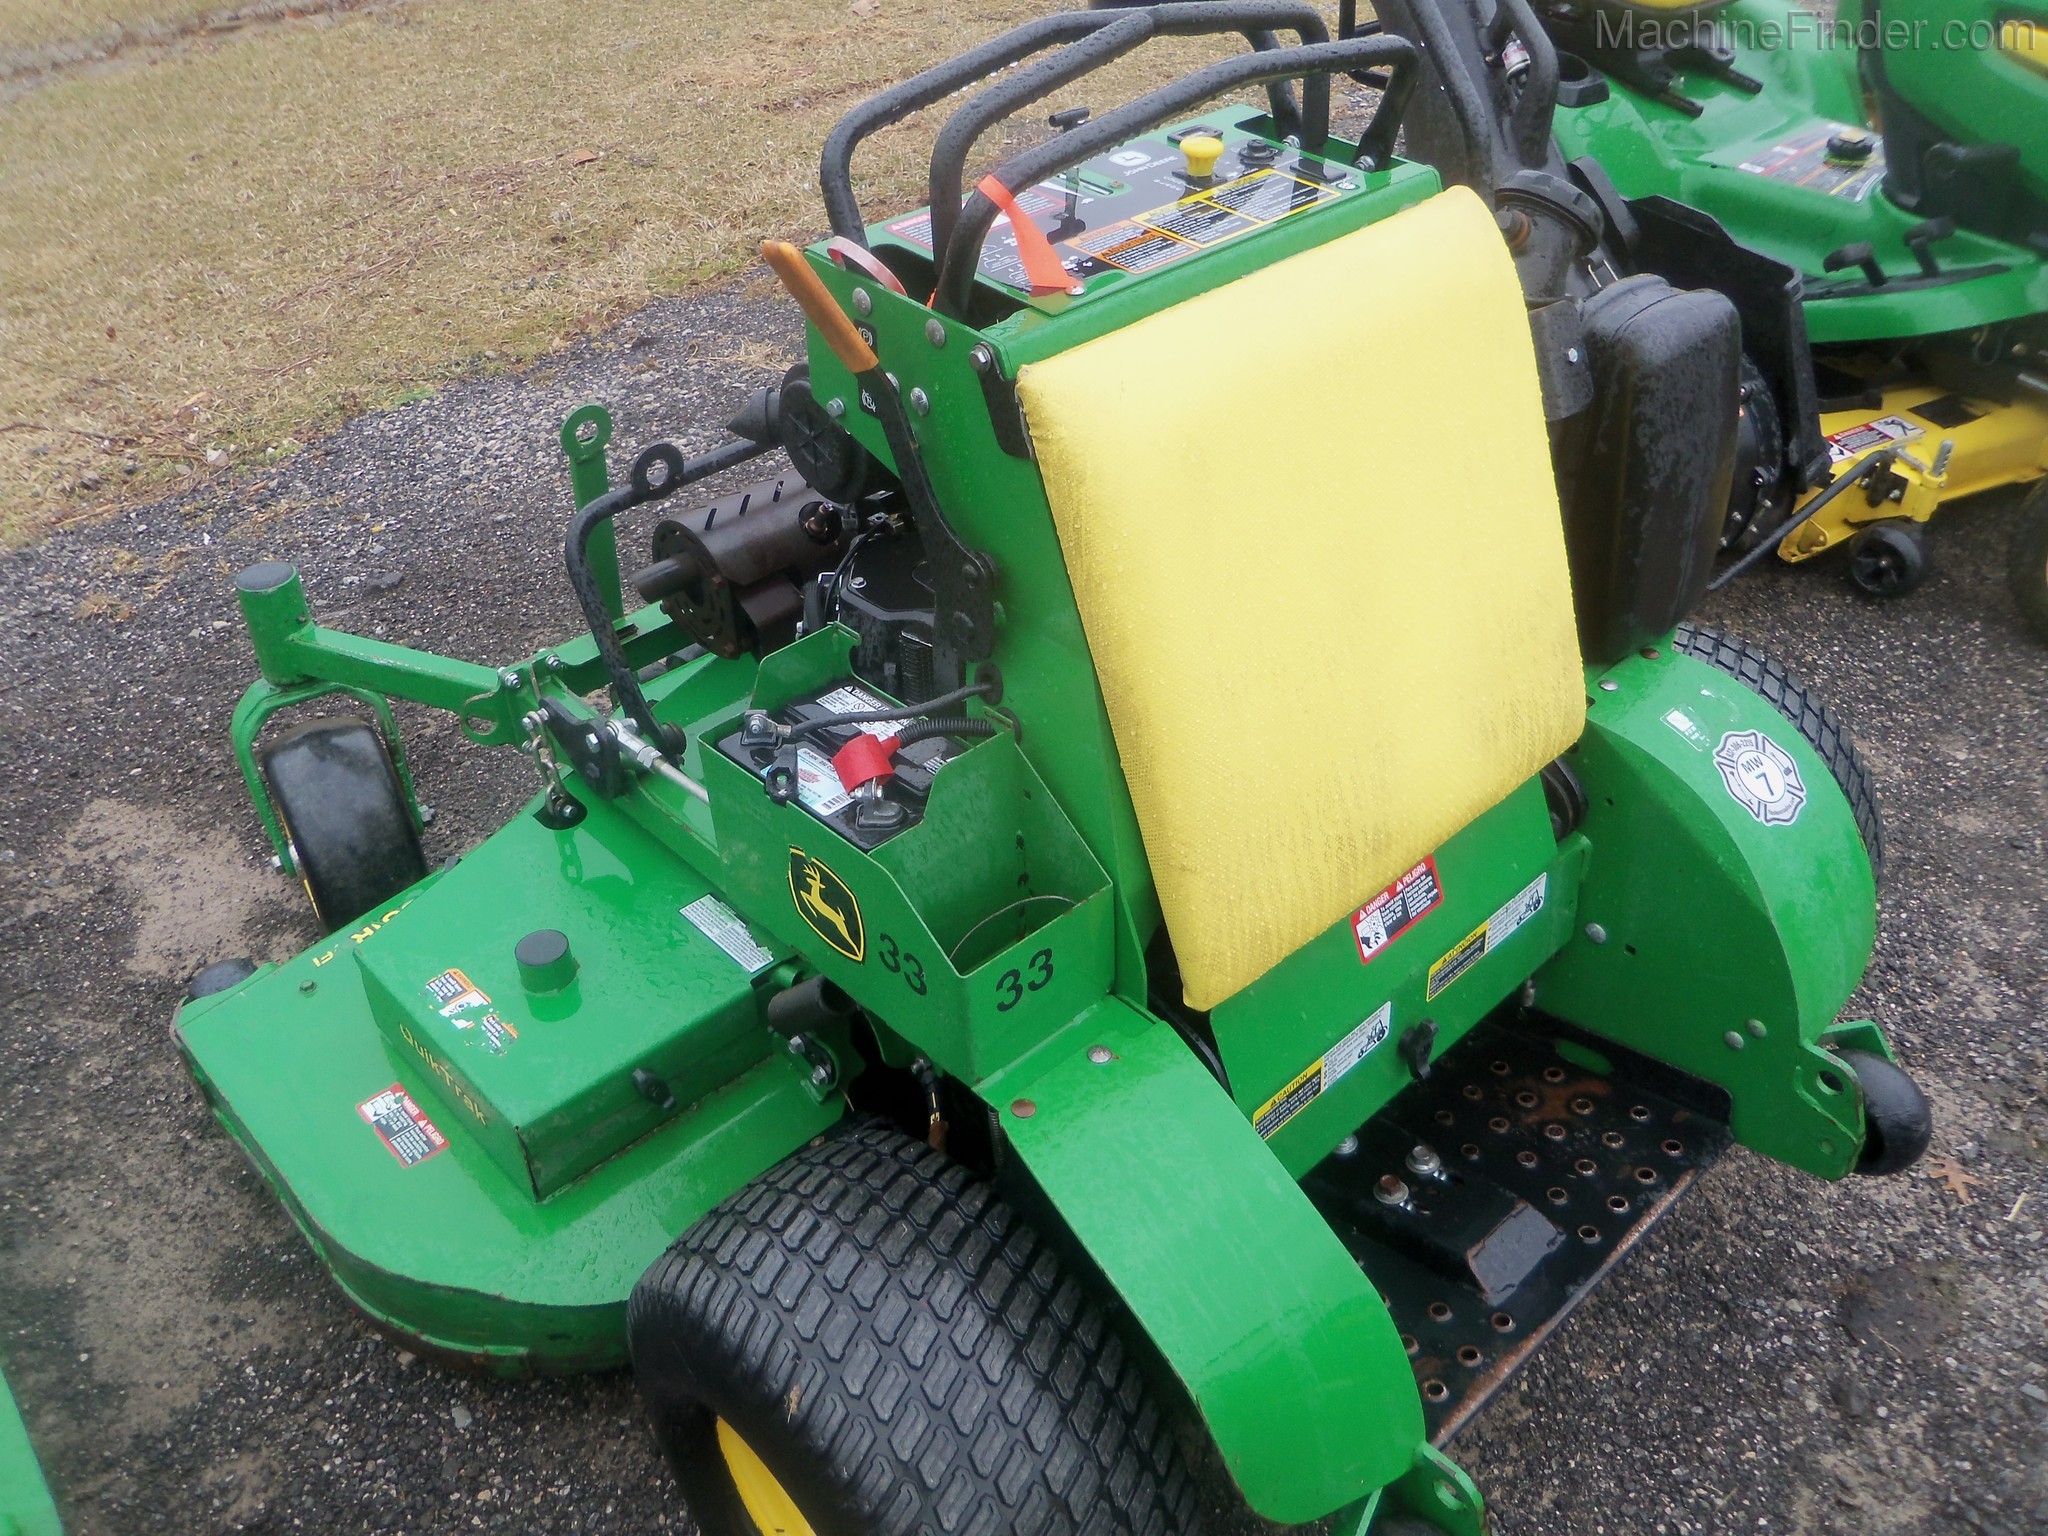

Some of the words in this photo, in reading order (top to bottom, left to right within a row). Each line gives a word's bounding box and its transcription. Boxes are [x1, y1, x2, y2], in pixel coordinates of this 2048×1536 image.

[1741, 755, 1763, 774] MW
[1755, 772, 1774, 796] 7
[1366, 892, 1390, 915] DANGER
[1402, 862, 1426, 886] PELIGRO
[879, 933, 927, 996] 33
[996, 948, 1054, 1012] 33
[1277, 1072, 1309, 1101] CAUTION
